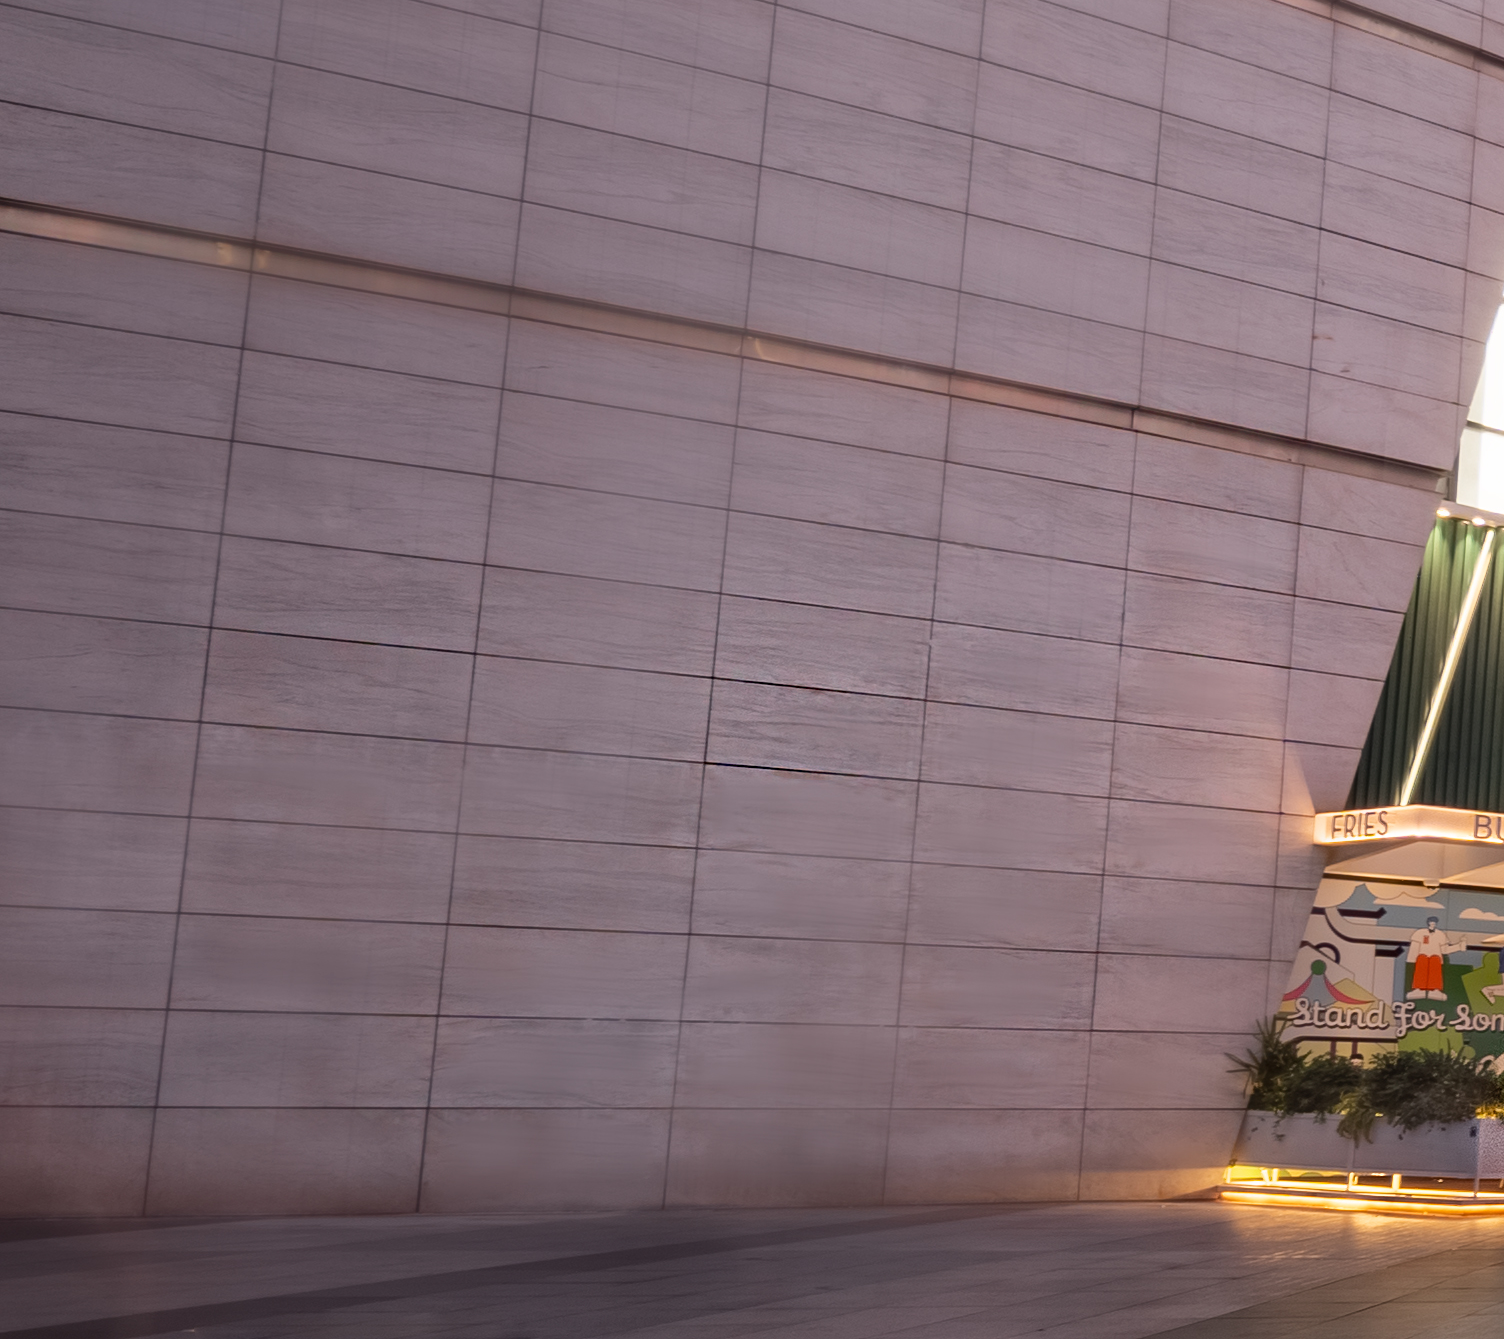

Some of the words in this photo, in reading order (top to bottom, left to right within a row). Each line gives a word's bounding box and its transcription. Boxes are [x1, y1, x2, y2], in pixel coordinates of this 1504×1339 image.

[1329, 809, 1389, 840] FRIES
[1286, 997, 1390, 1031] Stand
[1392, 998, 1450, 1039] For
